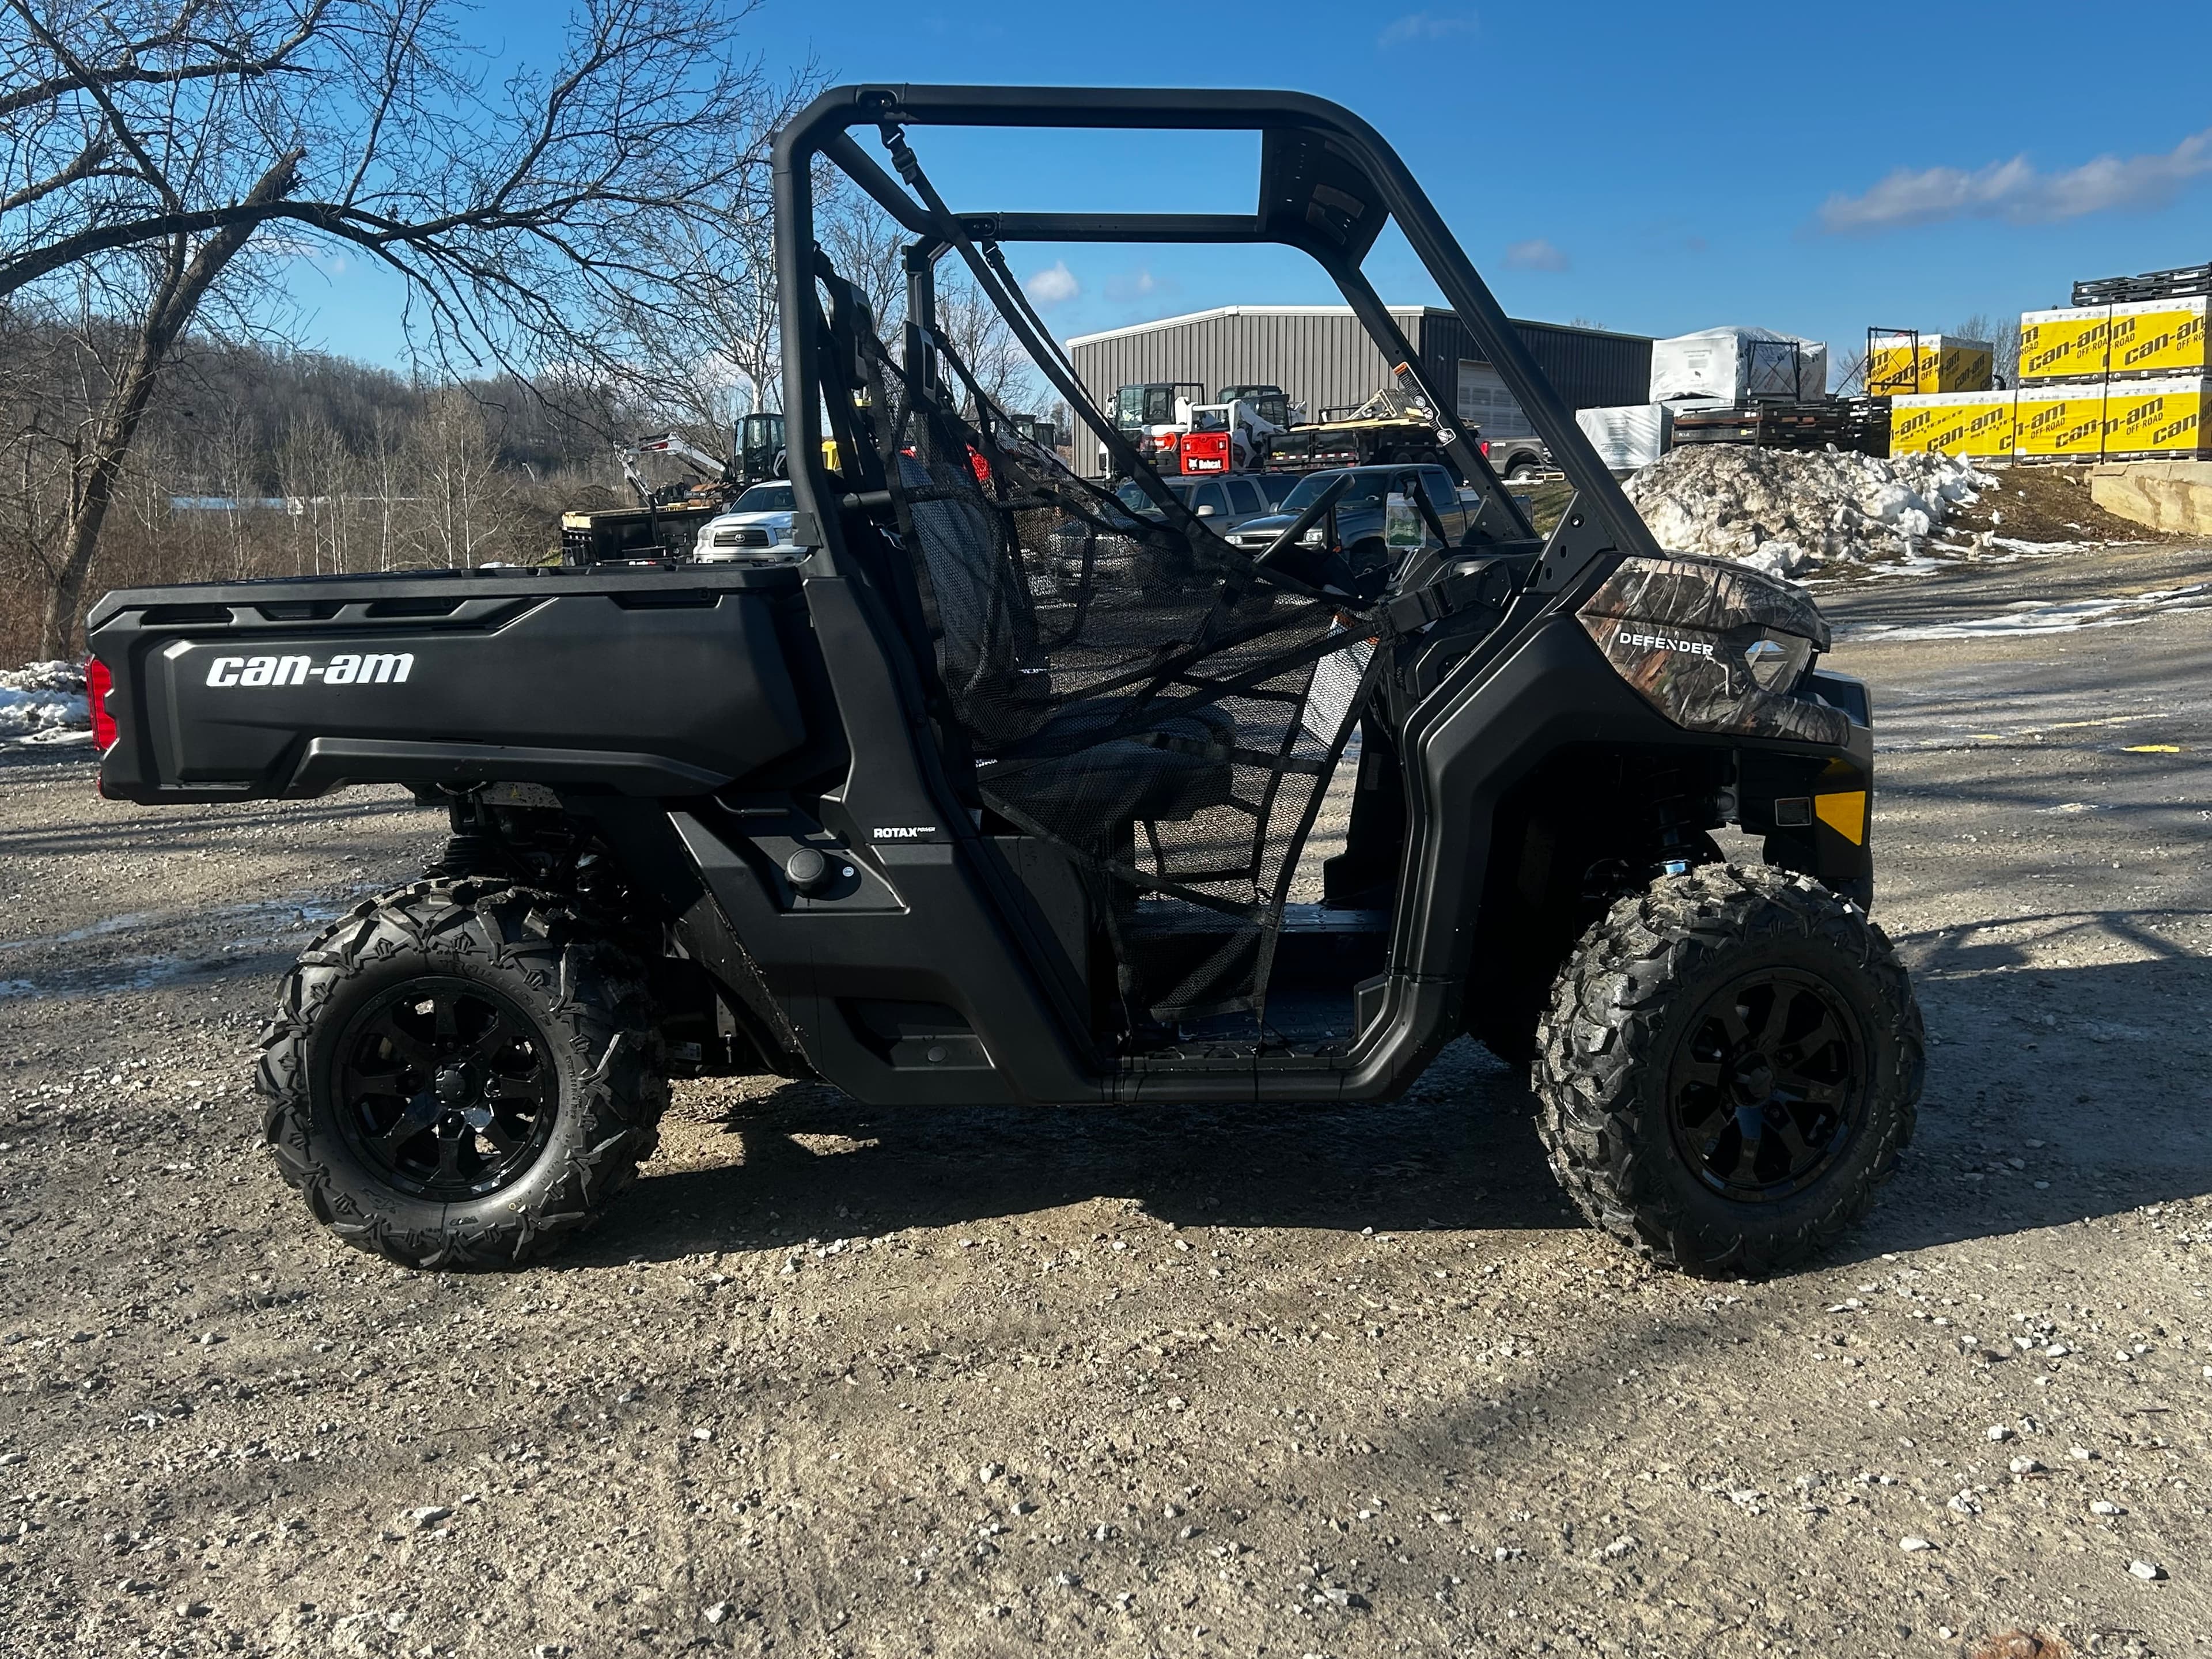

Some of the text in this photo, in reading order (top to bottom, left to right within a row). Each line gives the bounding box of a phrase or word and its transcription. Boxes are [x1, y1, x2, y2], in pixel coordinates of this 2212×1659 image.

[1619, 632, 1714, 656] DEFENDER
[206, 653, 415, 687] can-am
[873, 827, 918, 838] ROTAX
